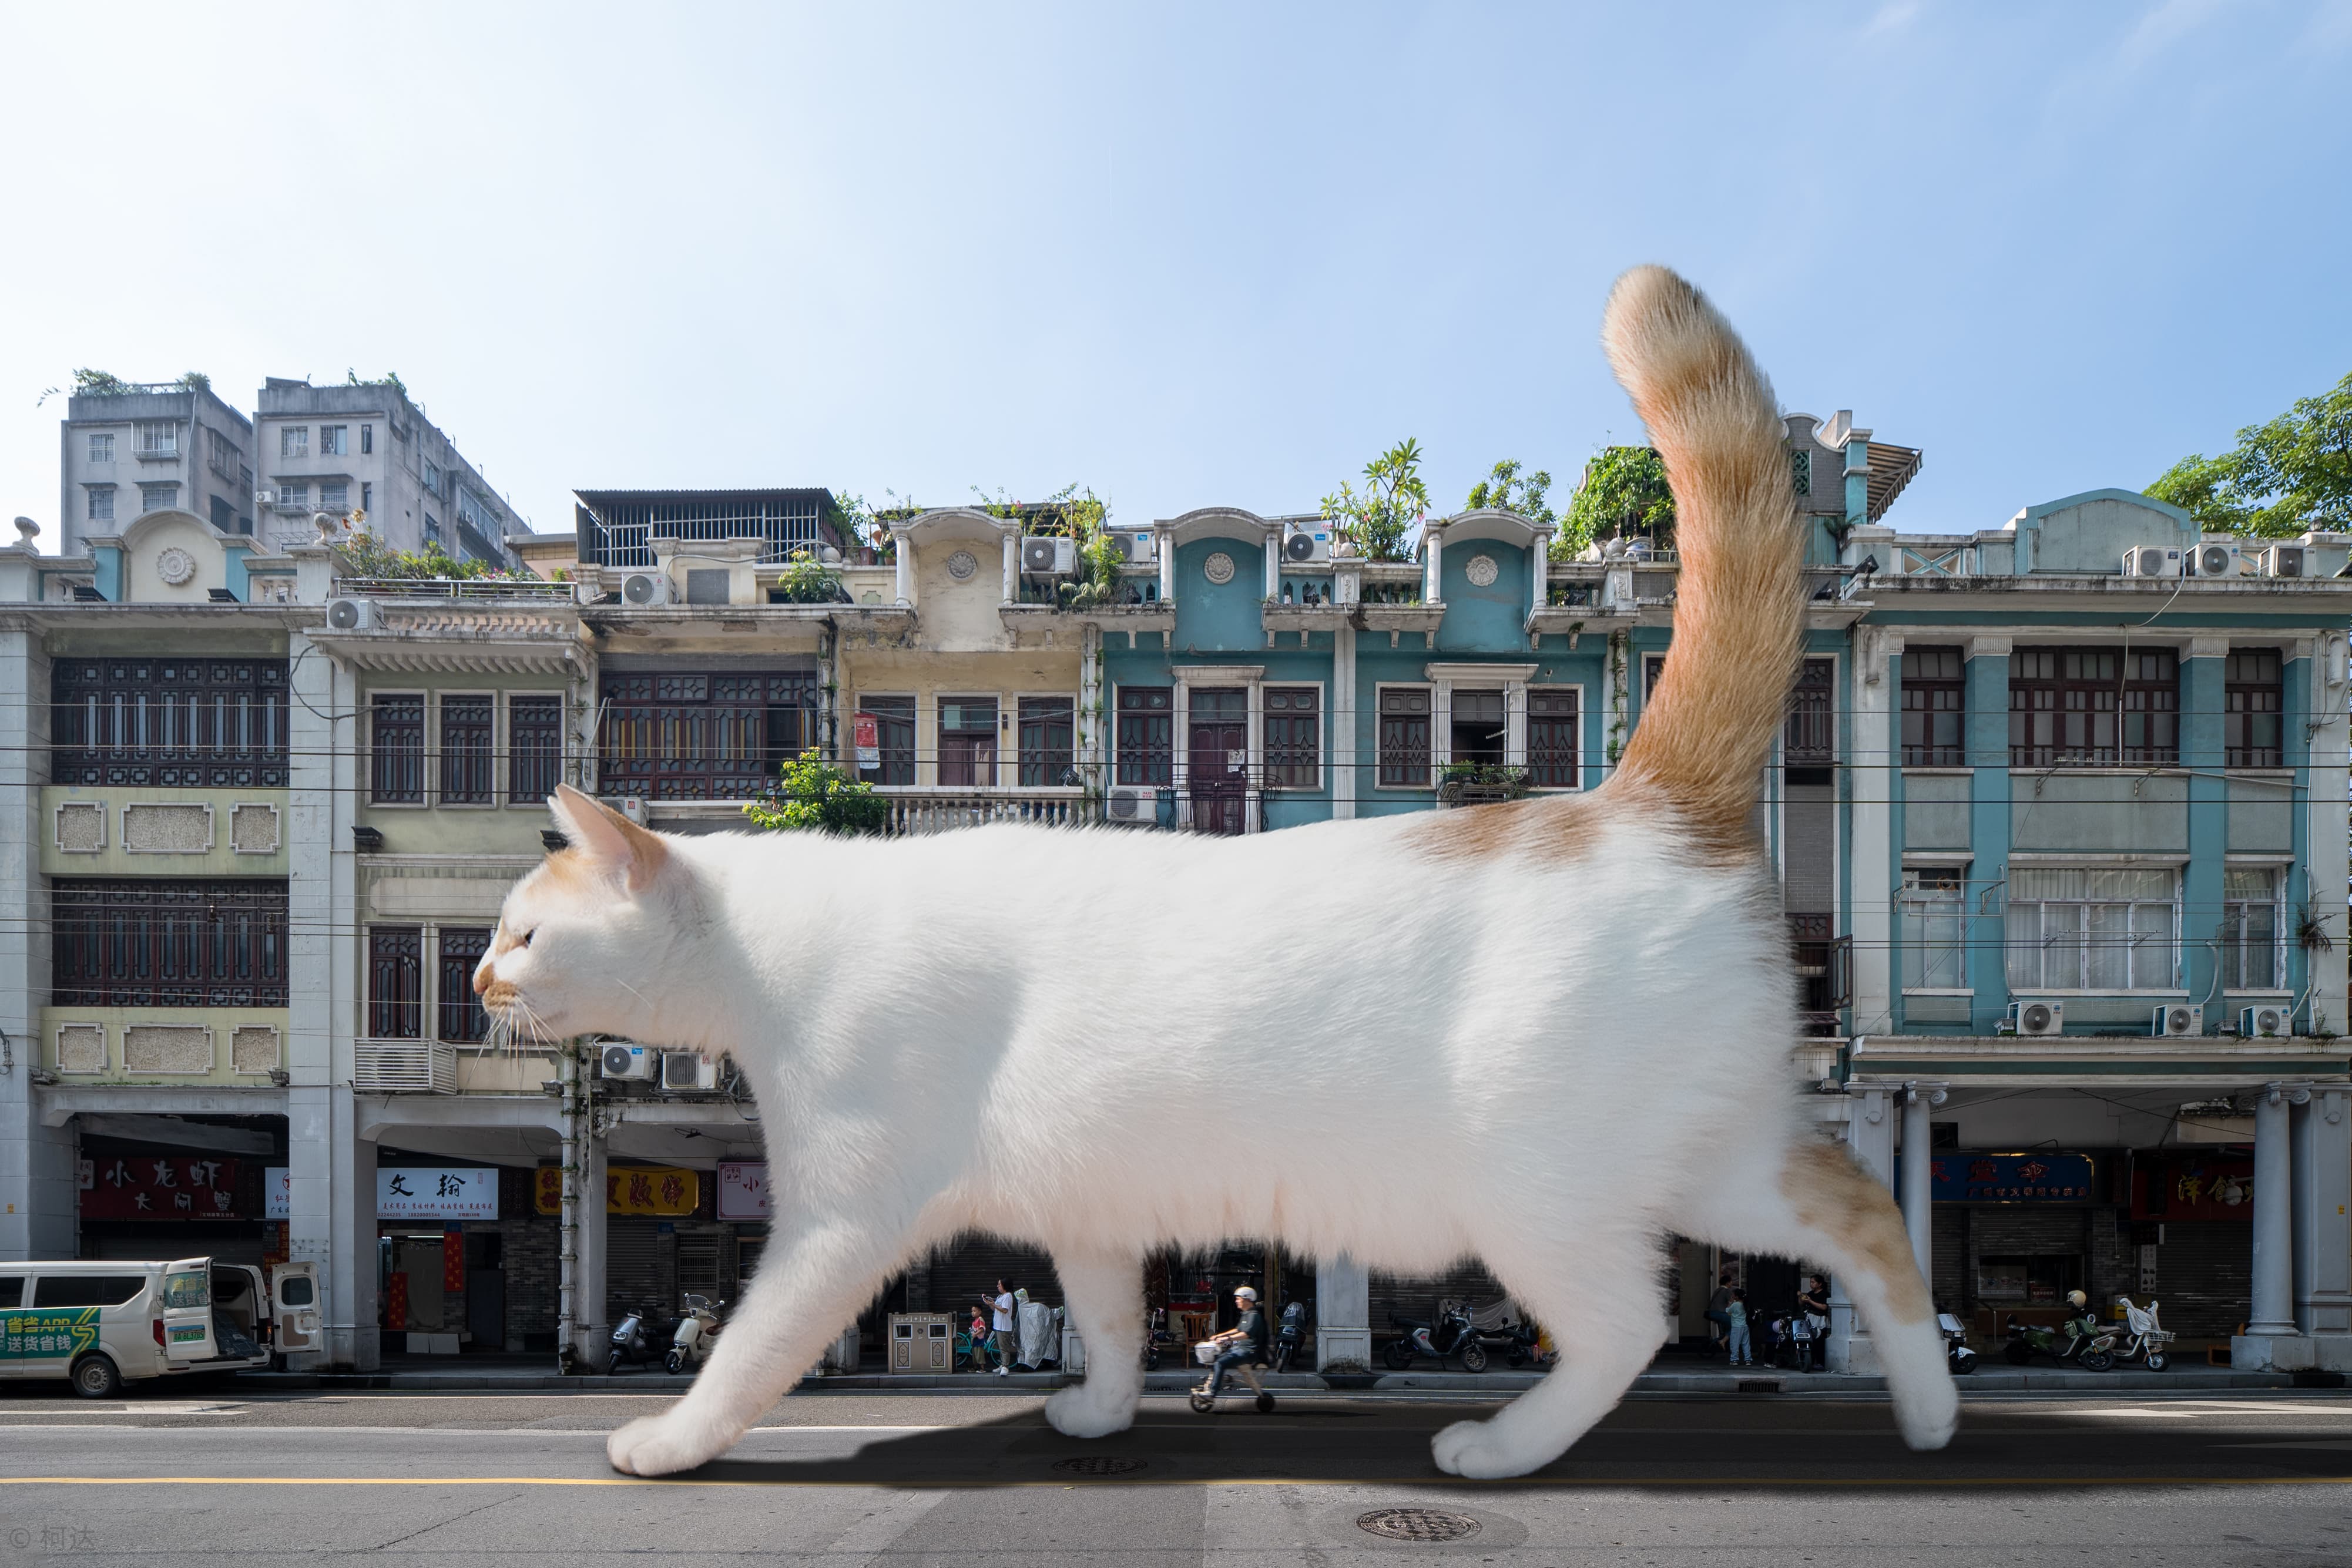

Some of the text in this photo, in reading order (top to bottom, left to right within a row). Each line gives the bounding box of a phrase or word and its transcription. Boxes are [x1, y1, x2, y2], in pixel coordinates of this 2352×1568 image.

[105, 1159, 222, 1190] 小龙虾
[1931, 1159, 2050, 1183] 天堂伞
[390, 1173, 466, 1197] 文翰
[134, 1191, 232, 1211] 大闸蟹
[7, 1335, 71, 1352] 送货省钱
